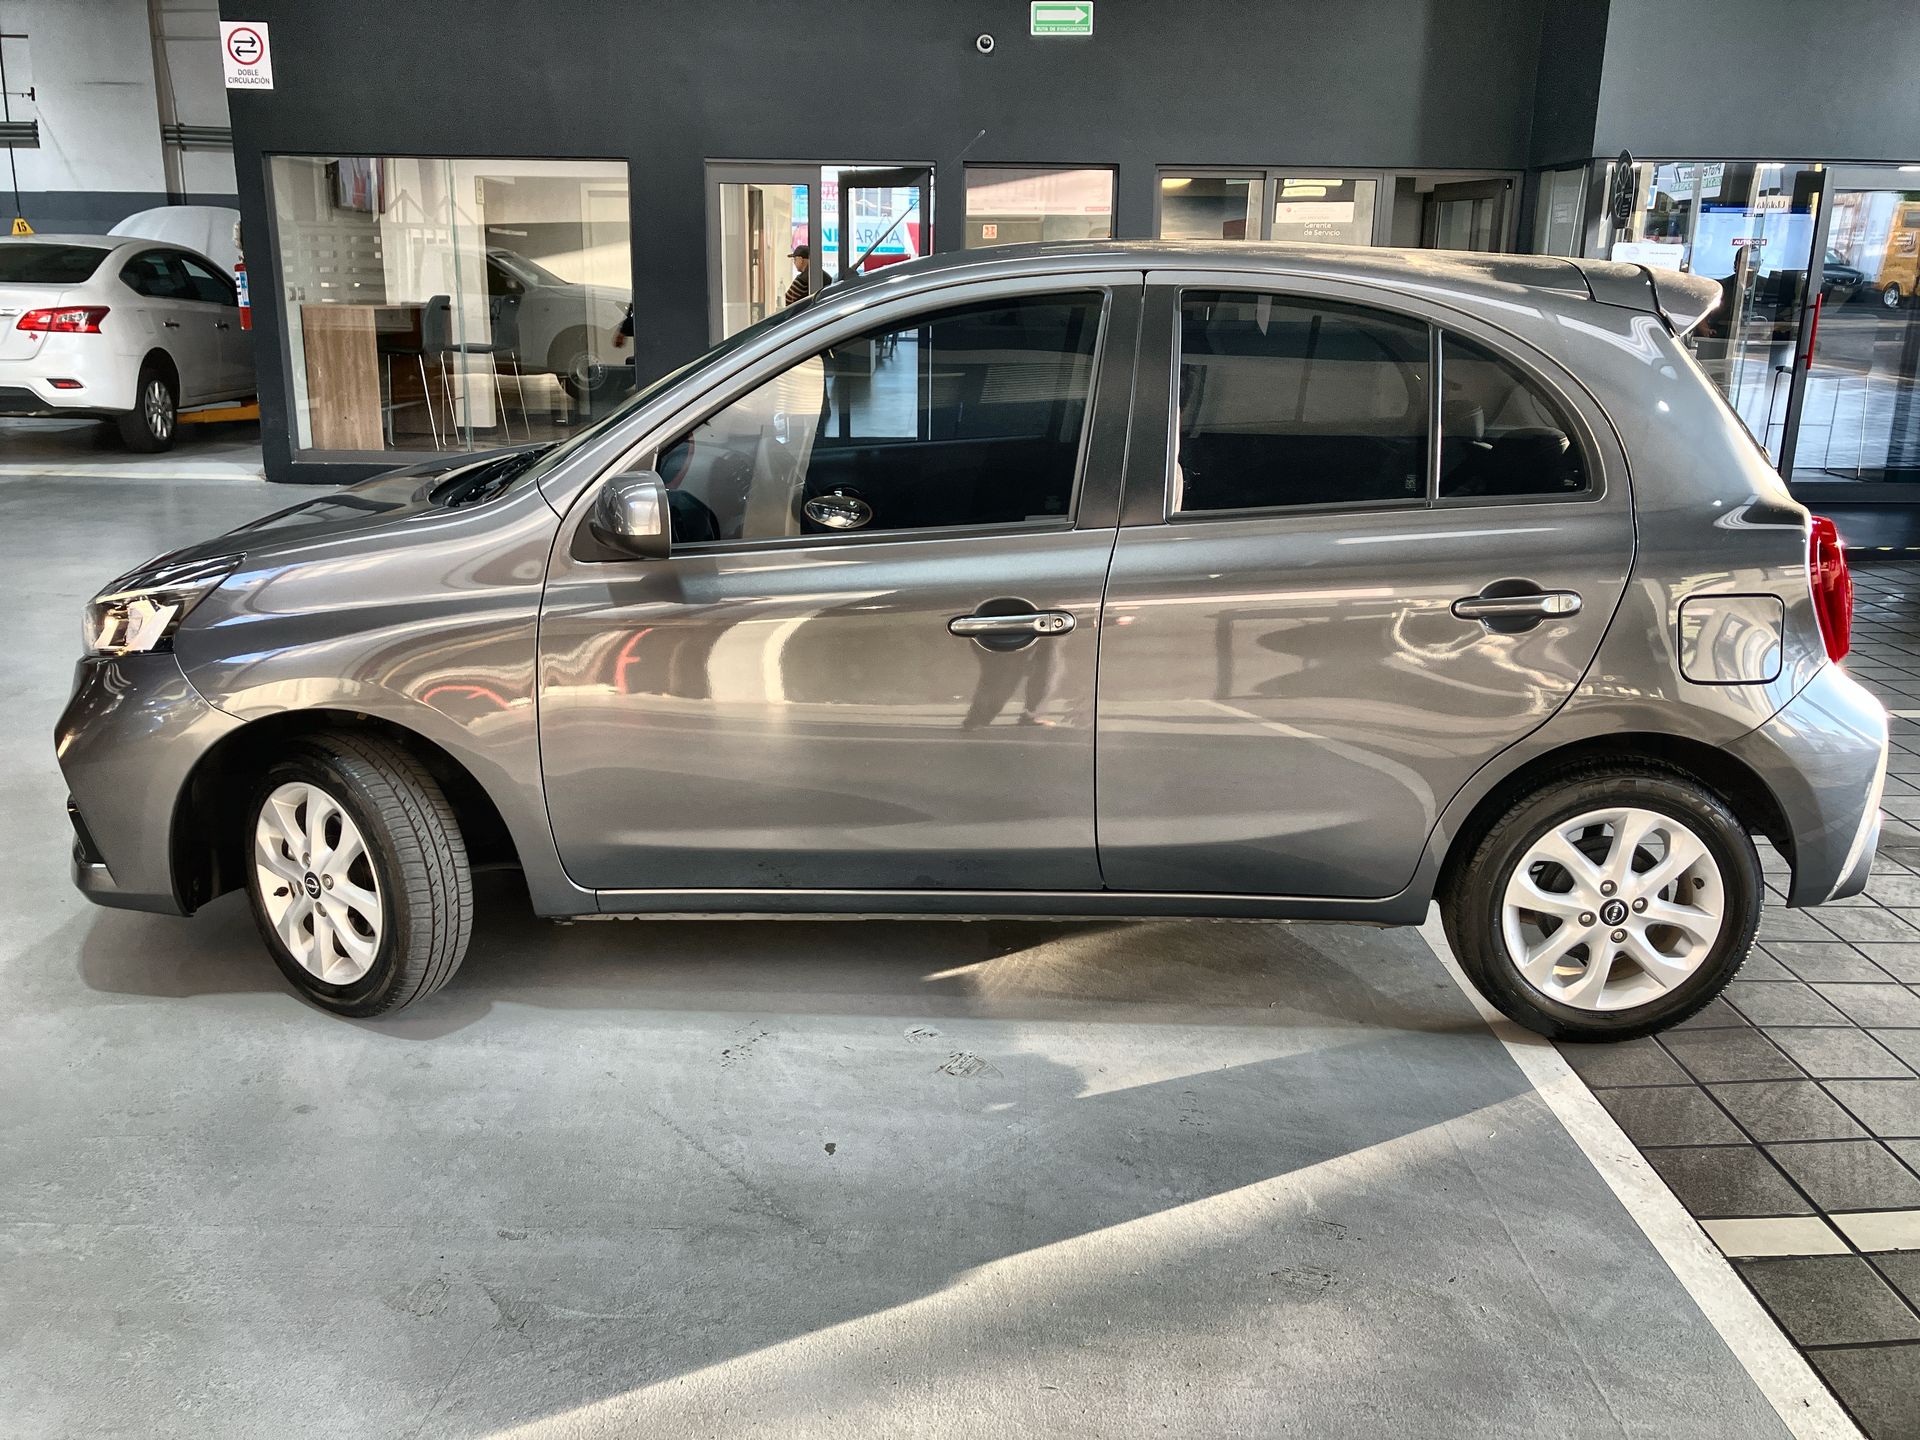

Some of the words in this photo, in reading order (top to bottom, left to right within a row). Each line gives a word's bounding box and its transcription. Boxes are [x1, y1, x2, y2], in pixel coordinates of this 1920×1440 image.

[237, 69, 259, 77] DOBLE
[227, 77, 271, 85] CIRCULACIÓN
[16, 221, 27, 232] 15
